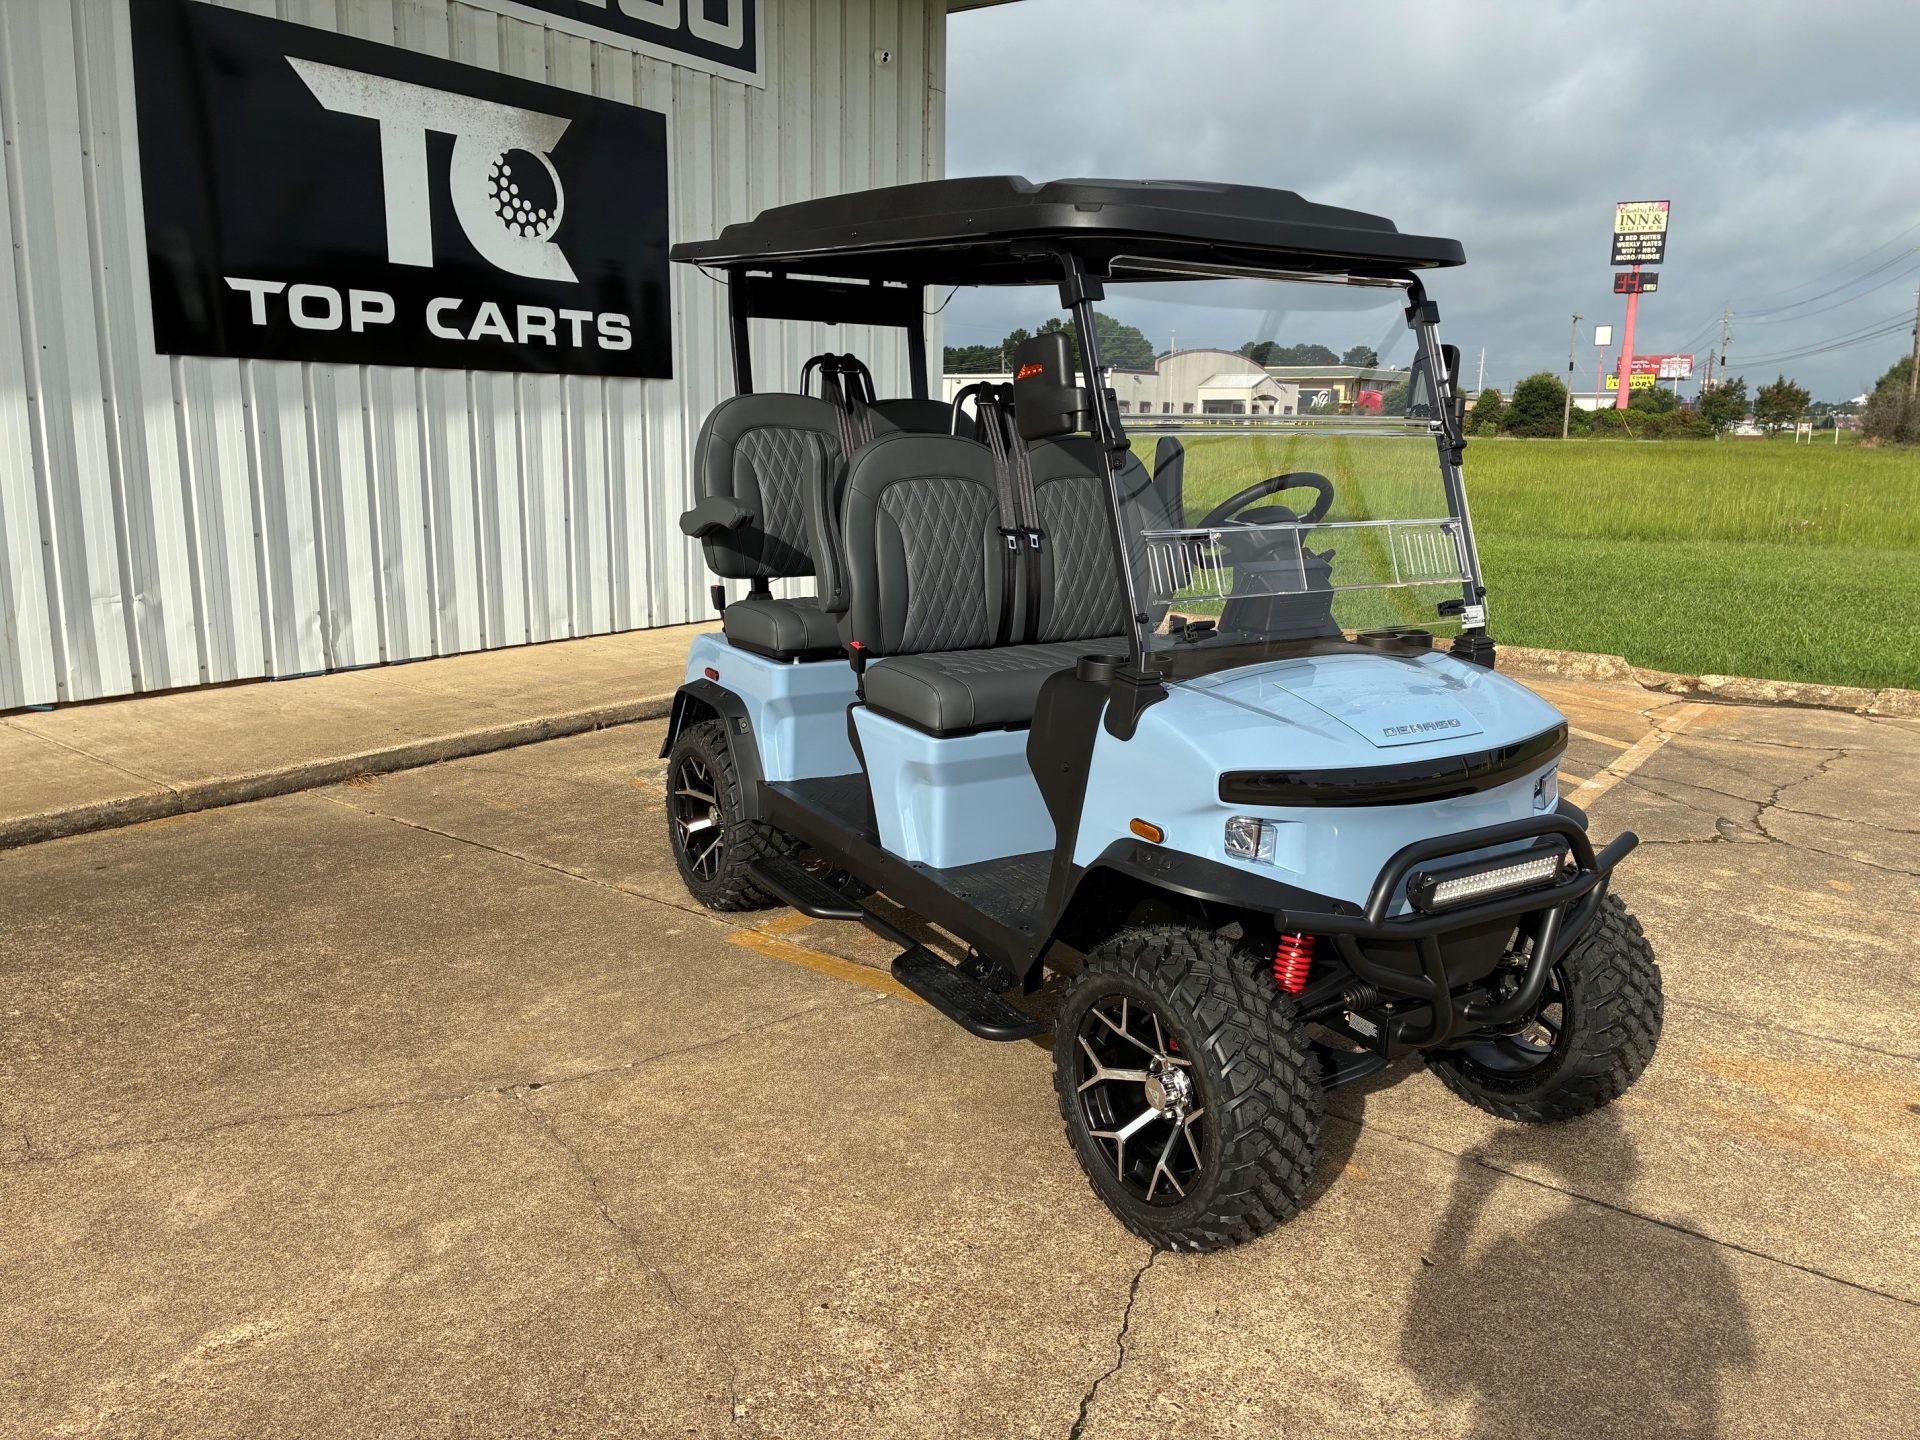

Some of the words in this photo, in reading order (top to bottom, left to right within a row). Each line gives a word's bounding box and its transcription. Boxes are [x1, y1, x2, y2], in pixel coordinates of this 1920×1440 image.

[1620, 214, 1649, 225] INN
[1652, 214, 1663, 225] &
[223, 276, 395, 332] TOP
[425, 296, 632, 350] CARTS
